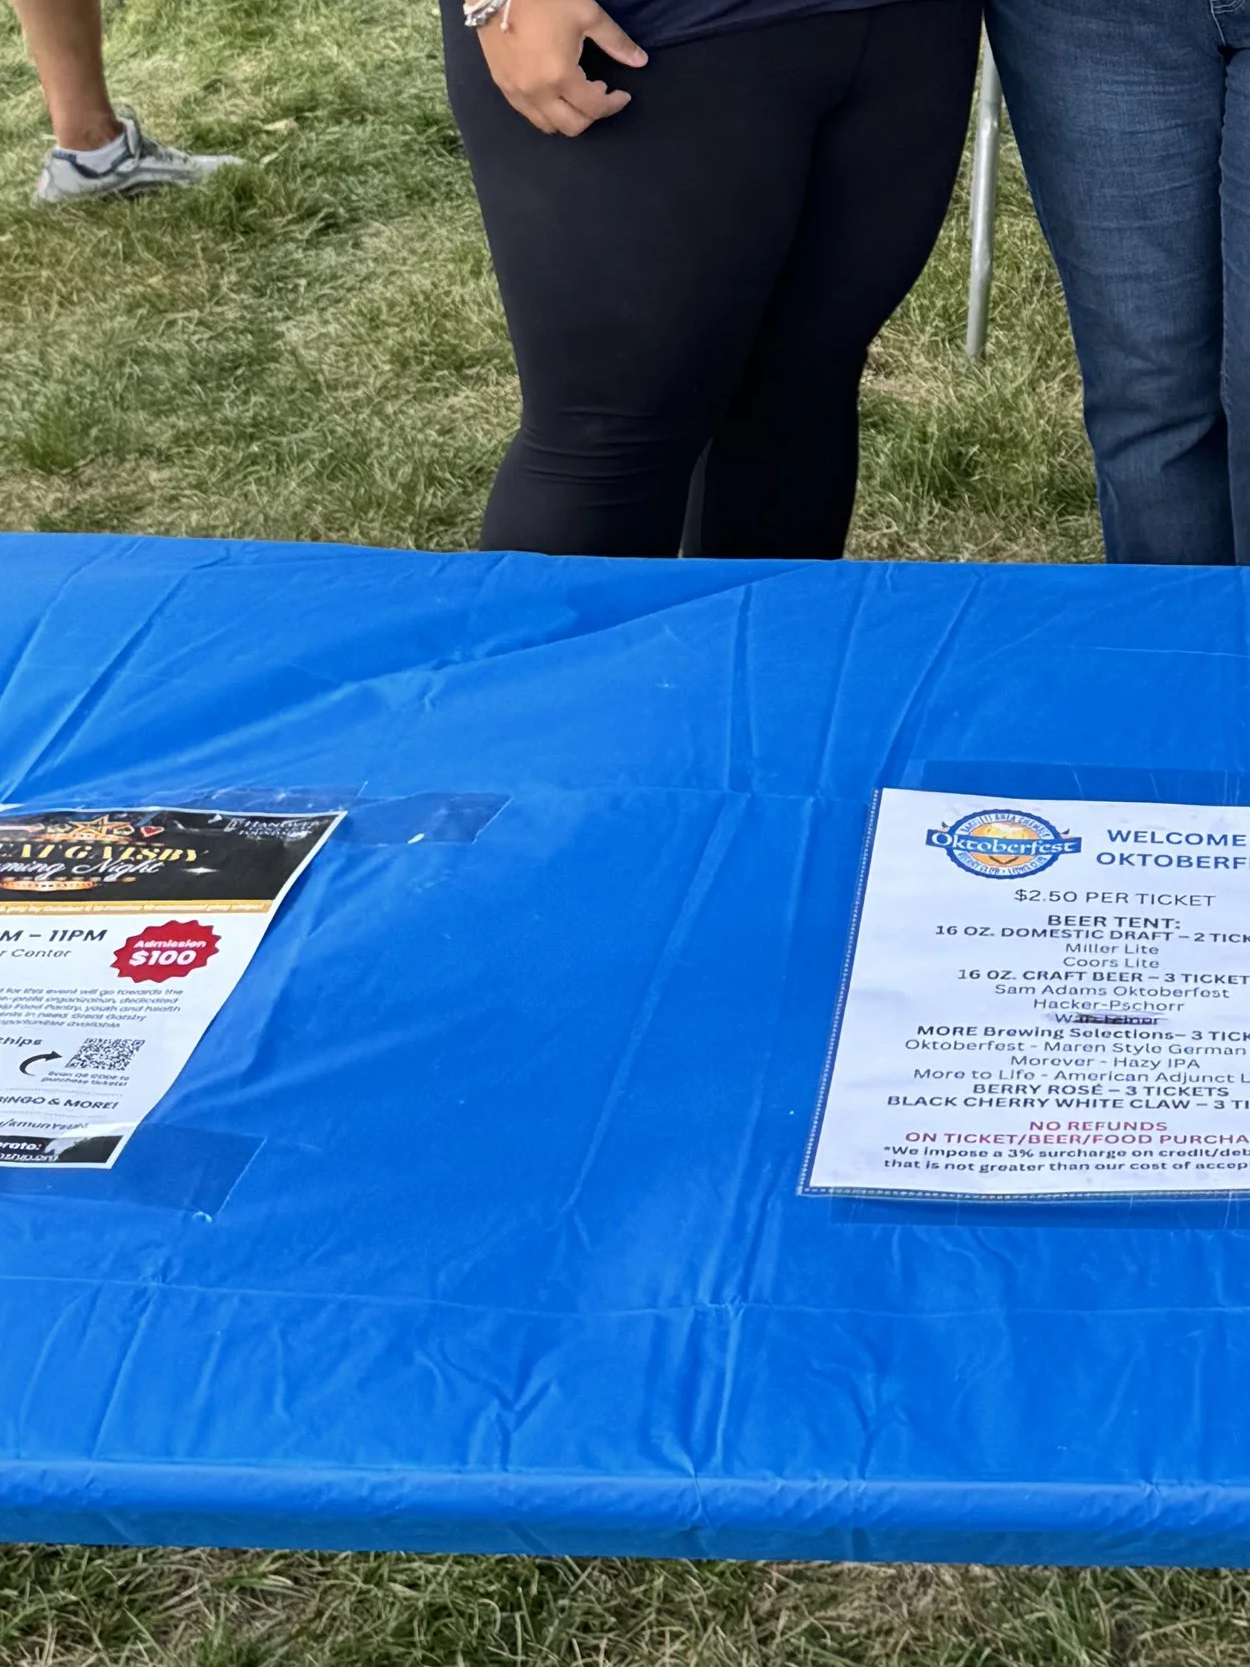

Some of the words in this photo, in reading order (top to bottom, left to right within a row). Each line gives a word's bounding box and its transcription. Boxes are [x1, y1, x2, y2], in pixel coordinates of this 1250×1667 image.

[931, 832, 1079, 855] Oktoberfest
[1107, 829, 1247, 847] WELCOME
[1014, 888, 1077, 904] $2.50
[1085, 891, 1129, 905] PER
[1135, 892, 1216, 907] TICKET
[1048, 914, 1107, 928] BEER
[1113, 916, 1181, 930] TENT:
[49, 929, 108, 942] 11PM
[935, 925, 958, 936] 16
[963, 926, 995, 937] OZ.
[1001, 927, 1105, 940] DOMESTIC
[1109, 929, 1172, 942] DRAFT
[1194, 932, 1206, 943] 2
[1065, 942, 1120, 955] Miller
[1124, 943, 1160, 955] Lite
[129, 950, 197, 966] $100
[1063, 956, 1119, 968] Coors
[1124, 957, 1160, 969] Lite
[958, 969, 981, 980] 16
[1022, 970, 1087, 982] CRAFT
[1092, 971, 1143, 982] BEER
[1164, 973, 1175, 983] 3
[995, 984, 1036, 995] Sam
[1041, 984, 1107, 996] Adams
[1113, 986, 1230, 998] Oktoberfest
[1033, 998, 1185, 1012] Hacker-Pschorr
[917, 1025, 978, 1036] MORE
[983, 1026, 1064, 1040] Brewing
[1191, 1031, 1203, 1040] 3
[905, 1039, 1025, 1051] Oktoberfest
[1044, 1041, 1106, 1053] Maren
[1112, 1043, 1162, 1055] Style
[1168, 1044, 1246, 1056] German
[1010, 1055, 1094, 1066] Morever
[1114, 1057, 1161, 1071] Hazy
[1167, 1058, 1200, 1069] IPA
[914, 1068, 965, 1080] More
[971, 1070, 992, 1080] to
[999, 1069, 1035, 1080] Life
[1053, 1070, 1149, 1082] American
[1155, 1072, 1235, 1084] Adjunct
[973, 1084, 1042, 1094] BERRY
[1047, 1082, 1104, 1095] ROSÉ
[1125, 1085, 1137, 1096] 3
[1143, 1086, 1229, 1097] TICKETS
[887, 1095, 958, 1107] BLACK
[963, 1097, 1050, 1108] CHERRY
[1054, 1098, 1124, 1109] WHITE
[1129, 1099, 1191, 1110] CLAW
[1213, 1100, 1225, 1110] 3
[1029, 1121, 1061, 1131] NO
[1068, 1121, 1168, 1131] REFUNDS
[905, 1132, 937, 1143] ON
[943, 1133, 1153, 1145] TICKET/BEER/FOOD
[924, 1146, 988, 1158] impose
[1007, 1149, 1034, 1158] 3%
[1038, 1149, 1127, 1160] surcharge
[1131, 1149, 1153, 1158] on
[884, 1159, 921, 1169] that
[926, 1160, 940, 1169] is
[945, 1162, 975, 1171] not
[979, 1162, 1046, 1174] greater
[1050, 1161, 1090, 1171] than
[1094, 1162, 1126, 1171] our
[1130, 1161, 1168, 1171] cost
[1172, 1160, 1192, 1170] of
